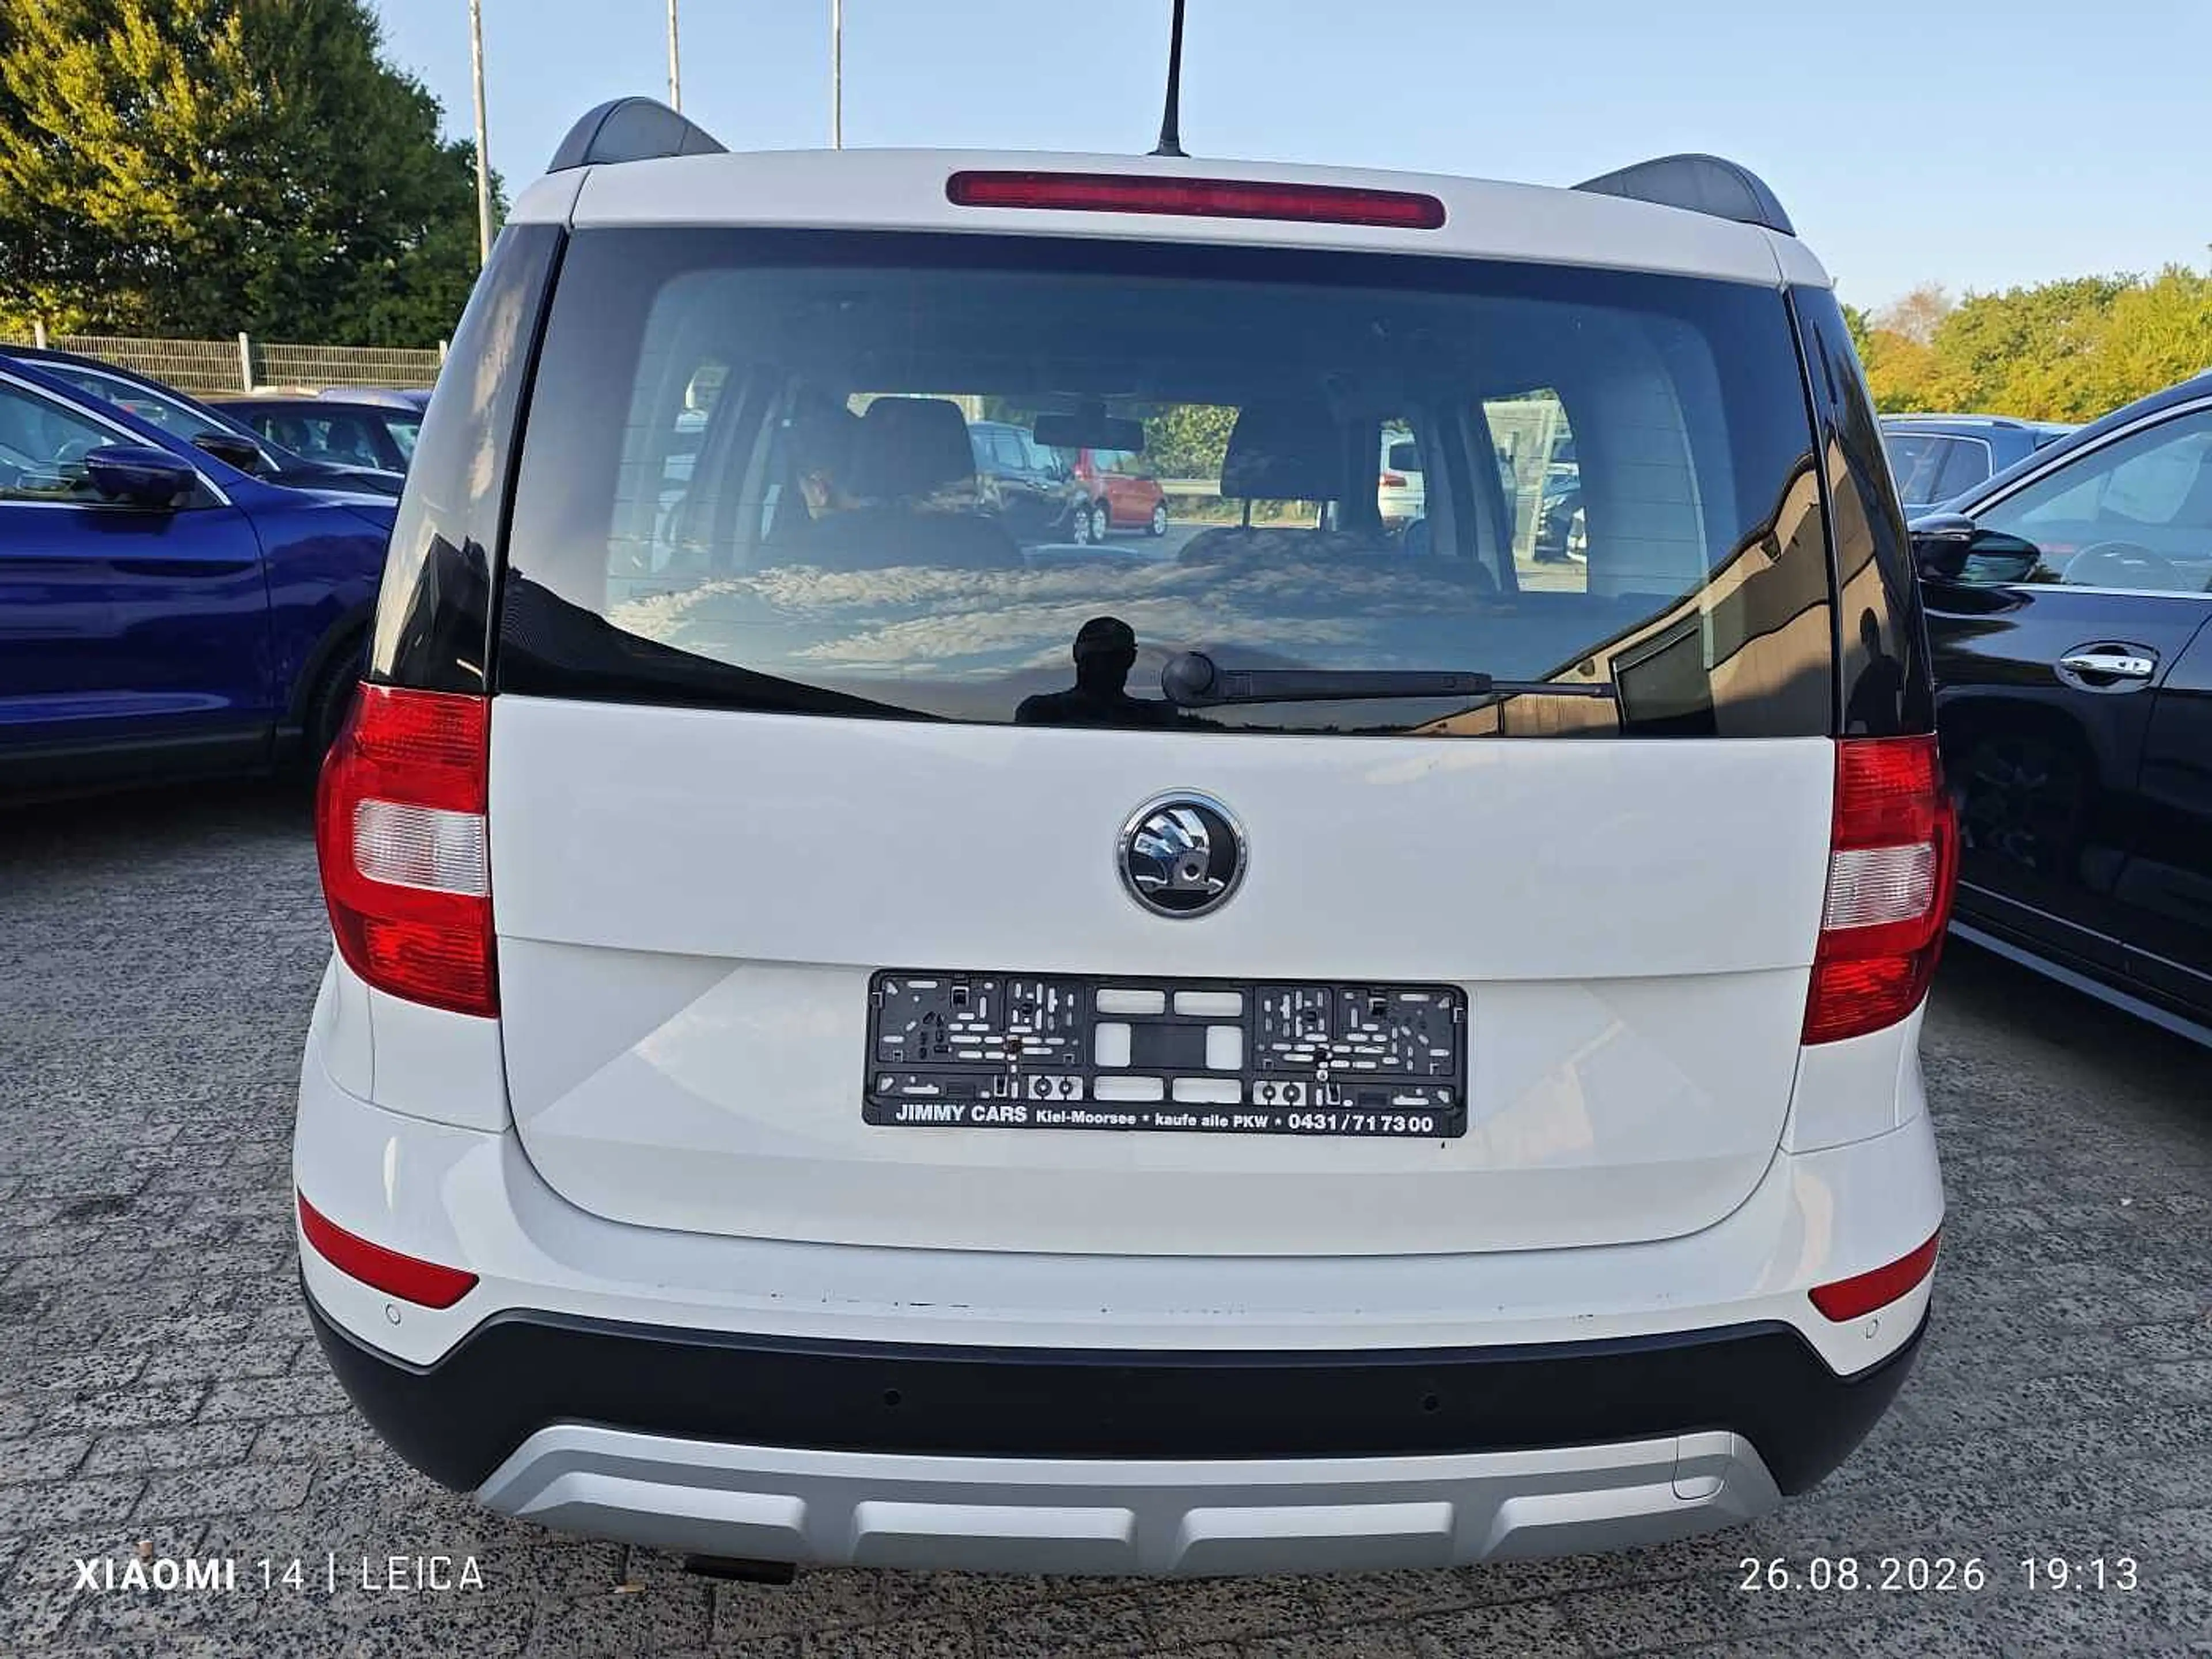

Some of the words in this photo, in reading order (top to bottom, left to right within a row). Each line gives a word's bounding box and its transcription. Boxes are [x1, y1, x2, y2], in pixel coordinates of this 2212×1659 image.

[896, 1104, 966, 1122] JIMMY
[971, 1105, 1028, 1123] CARS
[1036, 1109, 1137, 1125] Kiel-Moorsee
[1154, 1112, 1198, 1127] kaufe
[1233, 1114, 1269, 1128] PKW
